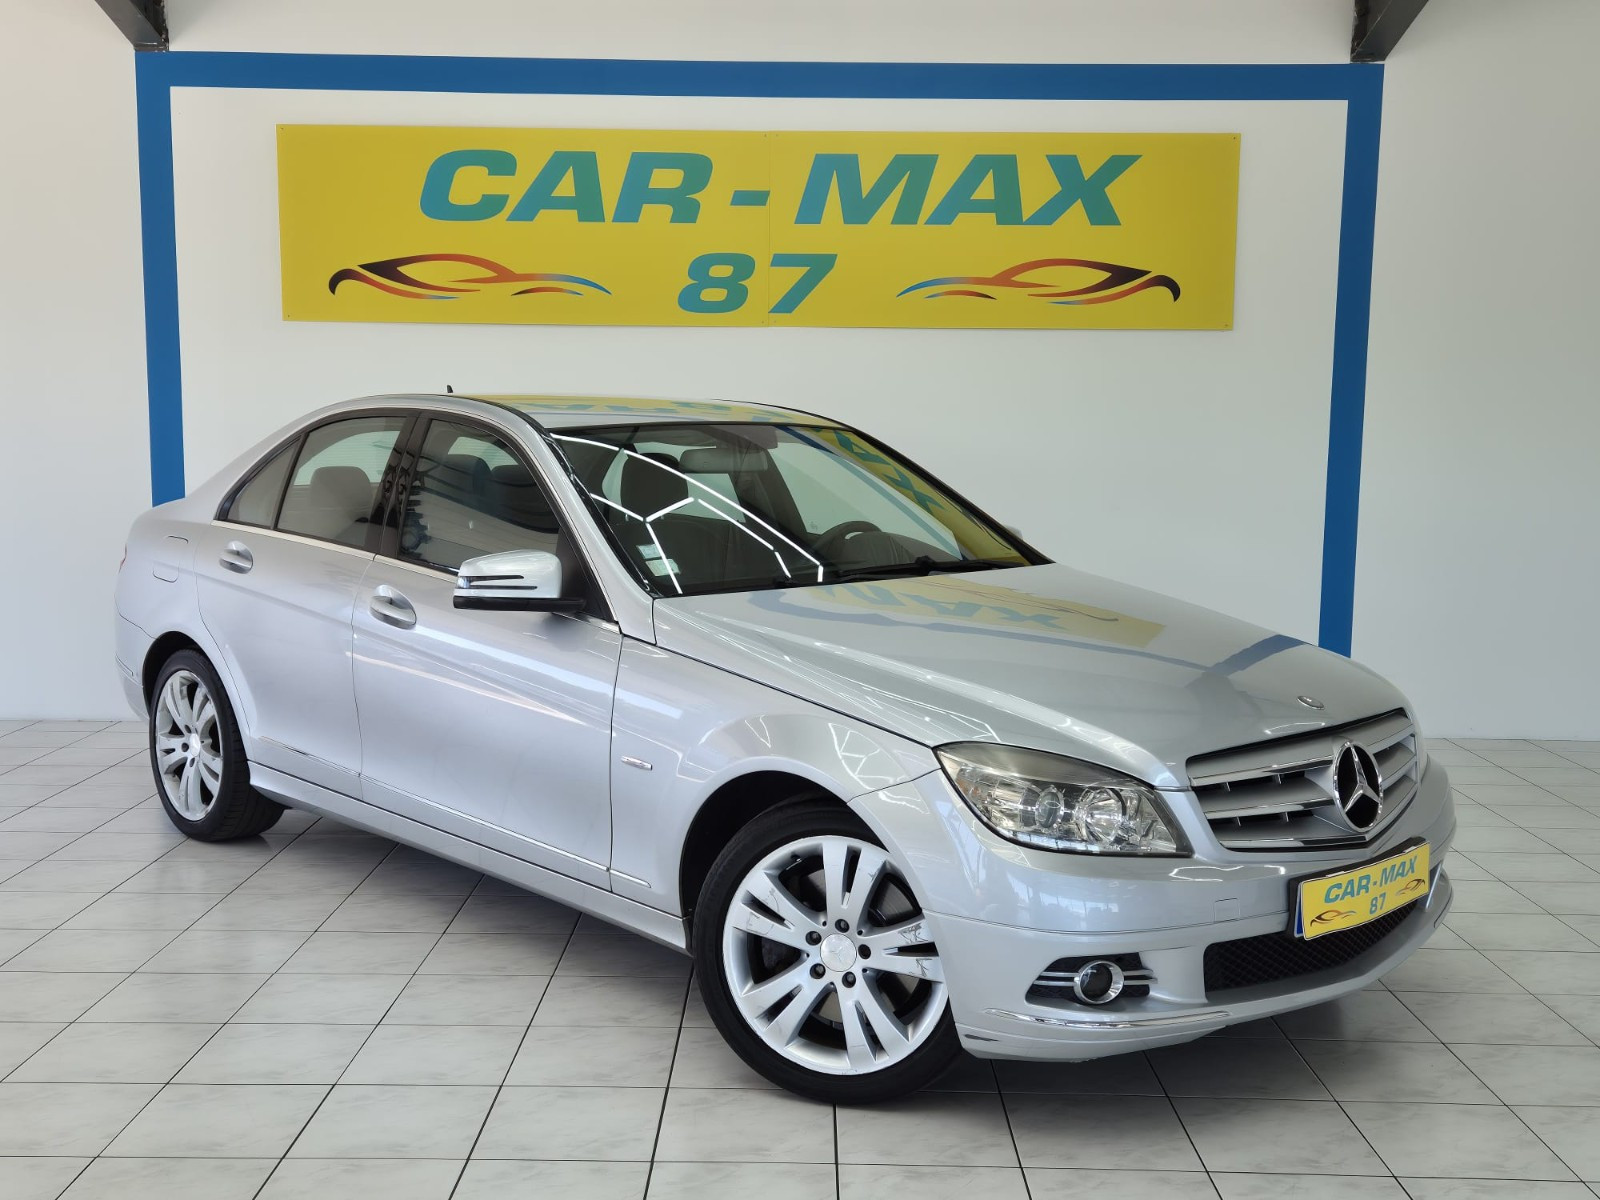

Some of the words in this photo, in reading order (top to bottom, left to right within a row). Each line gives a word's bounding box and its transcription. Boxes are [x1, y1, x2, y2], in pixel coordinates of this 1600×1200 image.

[419, 149, 713, 224] CAR
[795, 153, 1140, 226] MAX
[677, 253, 837, 314] 87
[1324, 874, 1371, 904] CAR
[1379, 855, 1418, 888] MAX
[1369, 892, 1387, 915] 87
